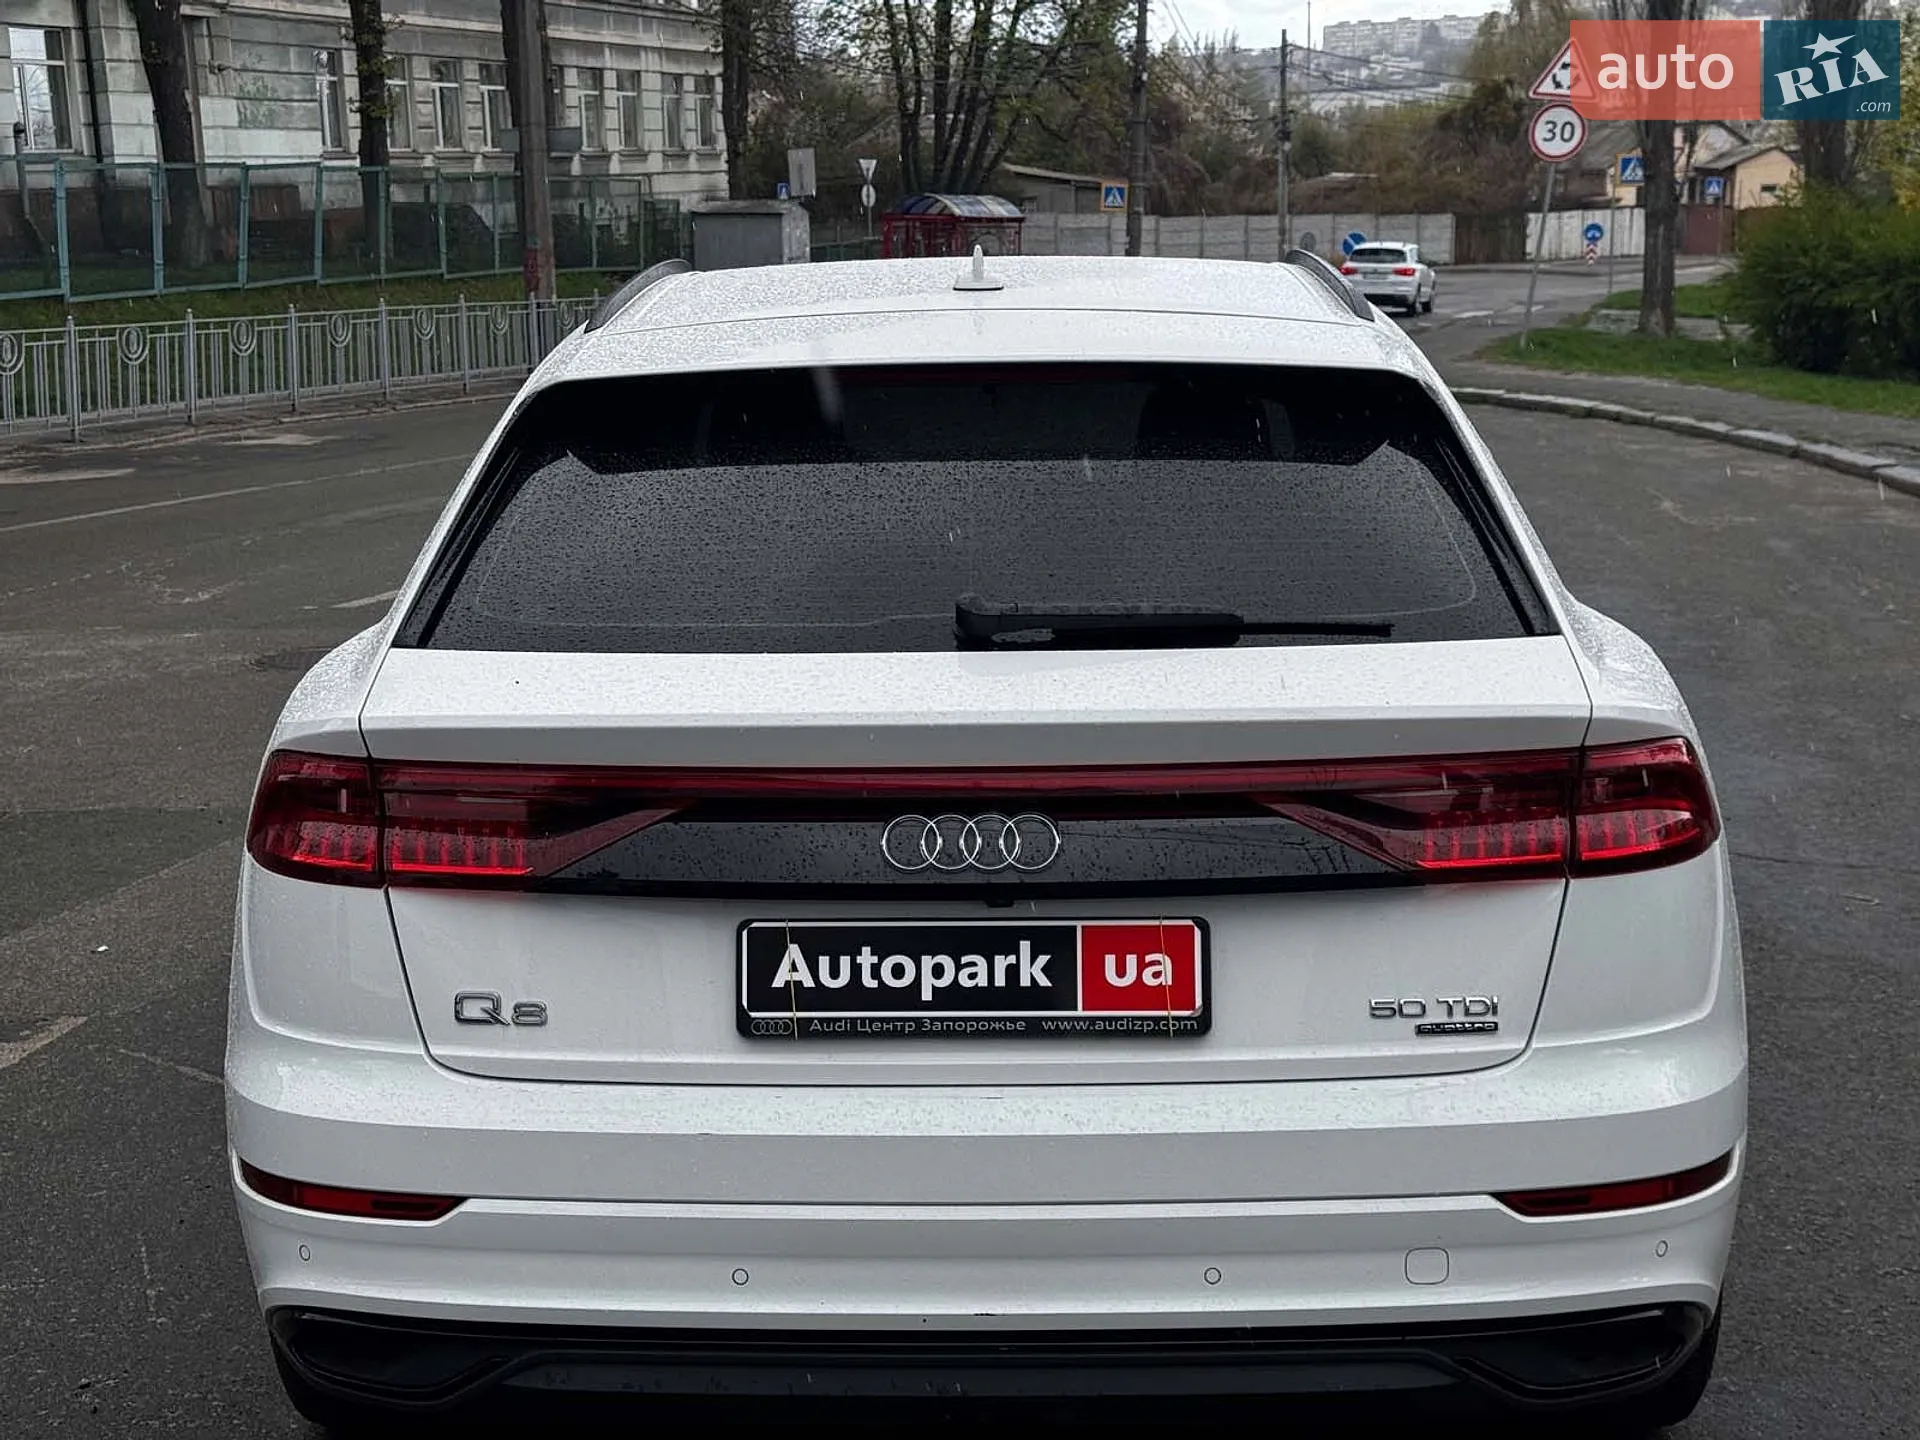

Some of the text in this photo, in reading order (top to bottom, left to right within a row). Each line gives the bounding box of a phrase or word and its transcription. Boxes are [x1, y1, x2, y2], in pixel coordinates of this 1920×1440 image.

[1543, 120, 1575, 142] 30
[771, 941, 1173, 1000] Autopark ua
[454, 991, 548, 1026] Q8
[1369, 996, 1498, 1018] 50 TDI
[809, 1019, 1027, 1034] Audi Центр Запорожье
[1042, 1018, 1198, 1033] www.audizp.com
